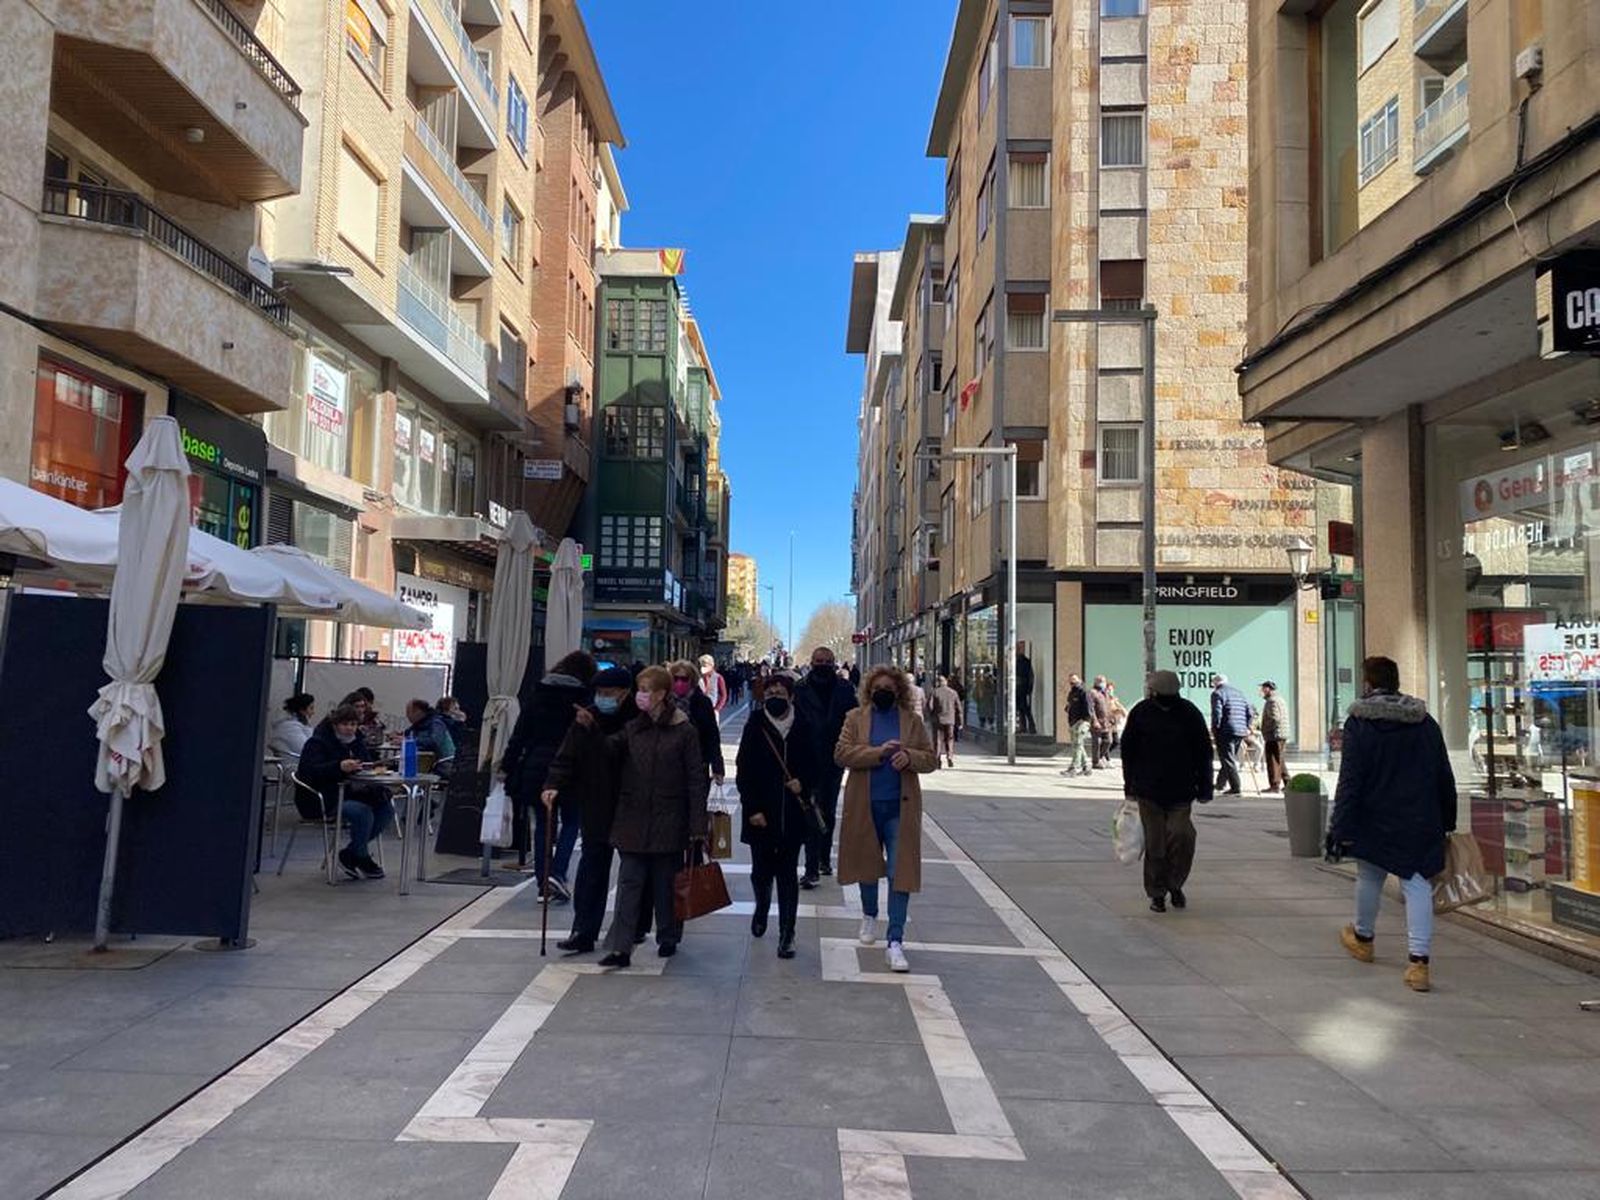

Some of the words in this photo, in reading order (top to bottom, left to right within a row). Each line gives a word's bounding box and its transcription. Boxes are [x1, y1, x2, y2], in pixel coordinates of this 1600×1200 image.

[1152, 586, 1238, 599] PRINGFIELD
[1169, 628, 1215, 646] ENJOY
[1173, 651, 1212, 667] YOUR
[1179, 672, 1217, 689] TORE
